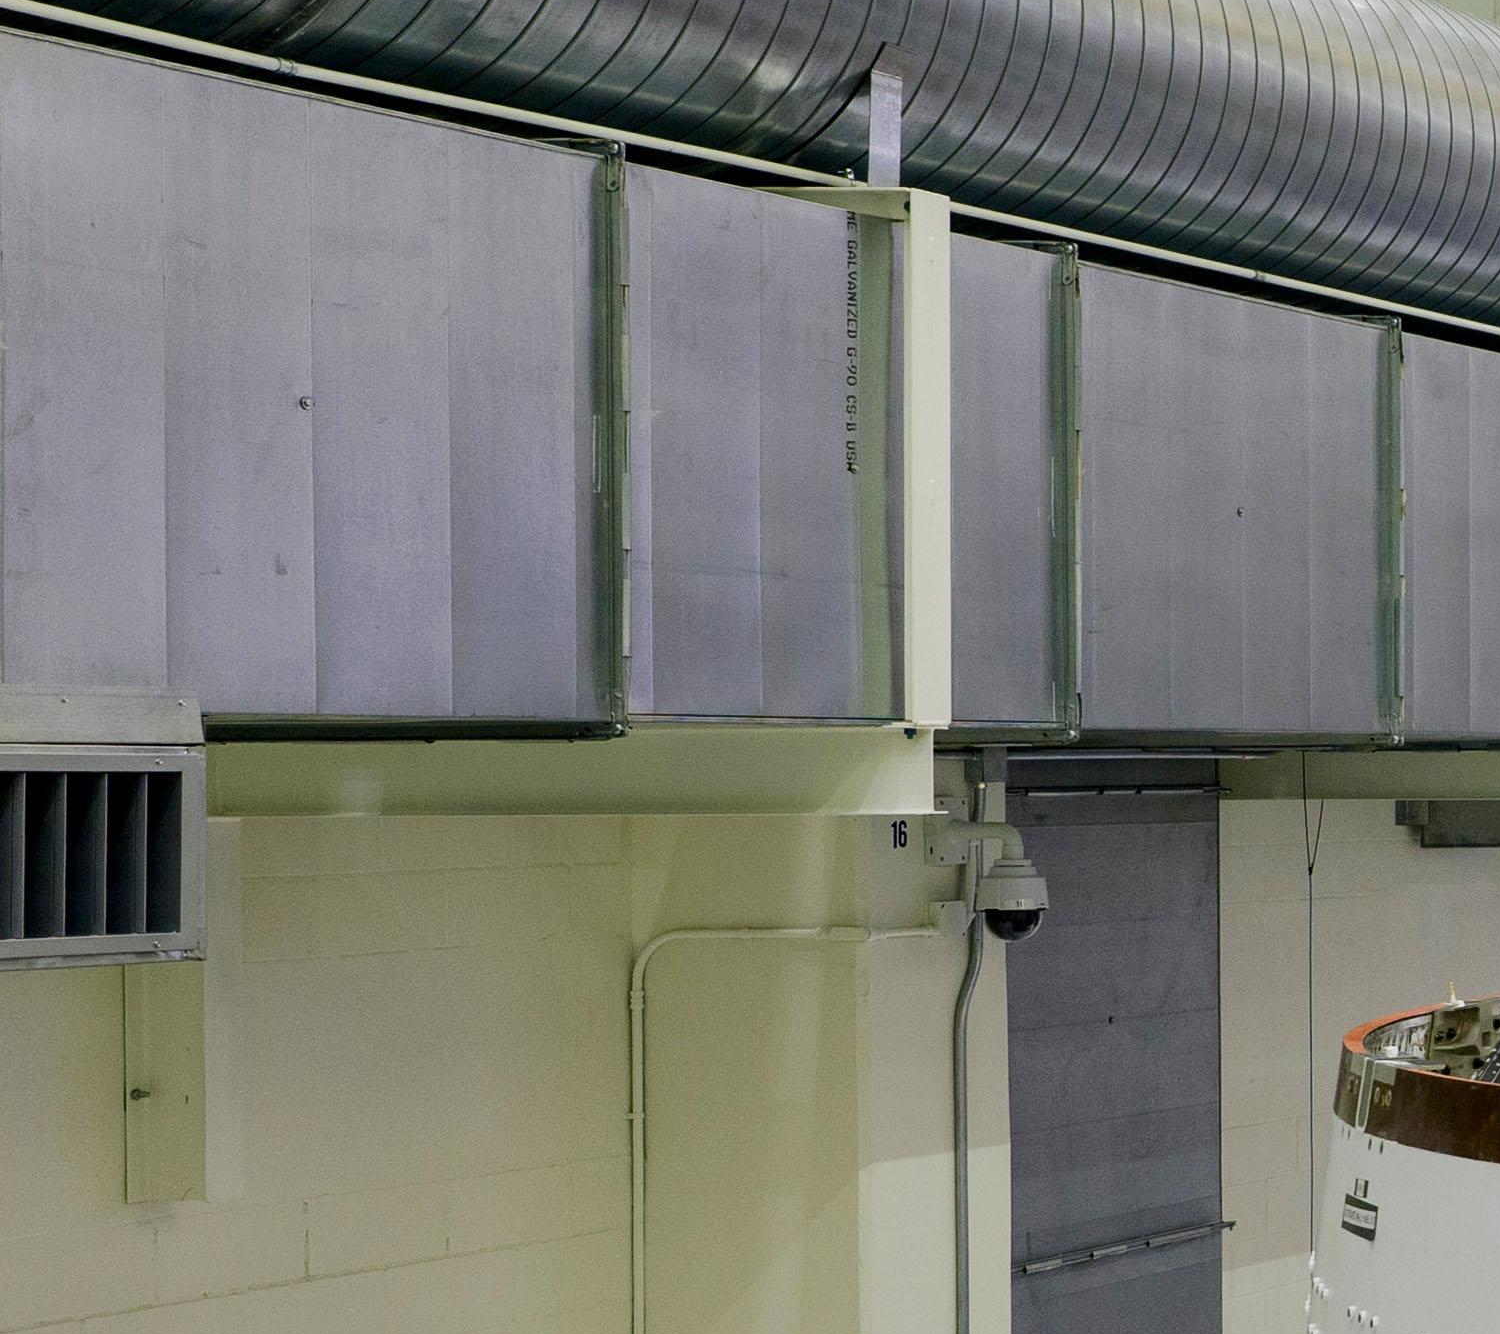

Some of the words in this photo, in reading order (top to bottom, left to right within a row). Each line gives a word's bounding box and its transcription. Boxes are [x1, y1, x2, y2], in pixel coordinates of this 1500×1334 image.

[846, 239, 857, 339] GALVANIZED
[846, 348, 857, 386] G-90
[890, 820, 907, 848] 16
